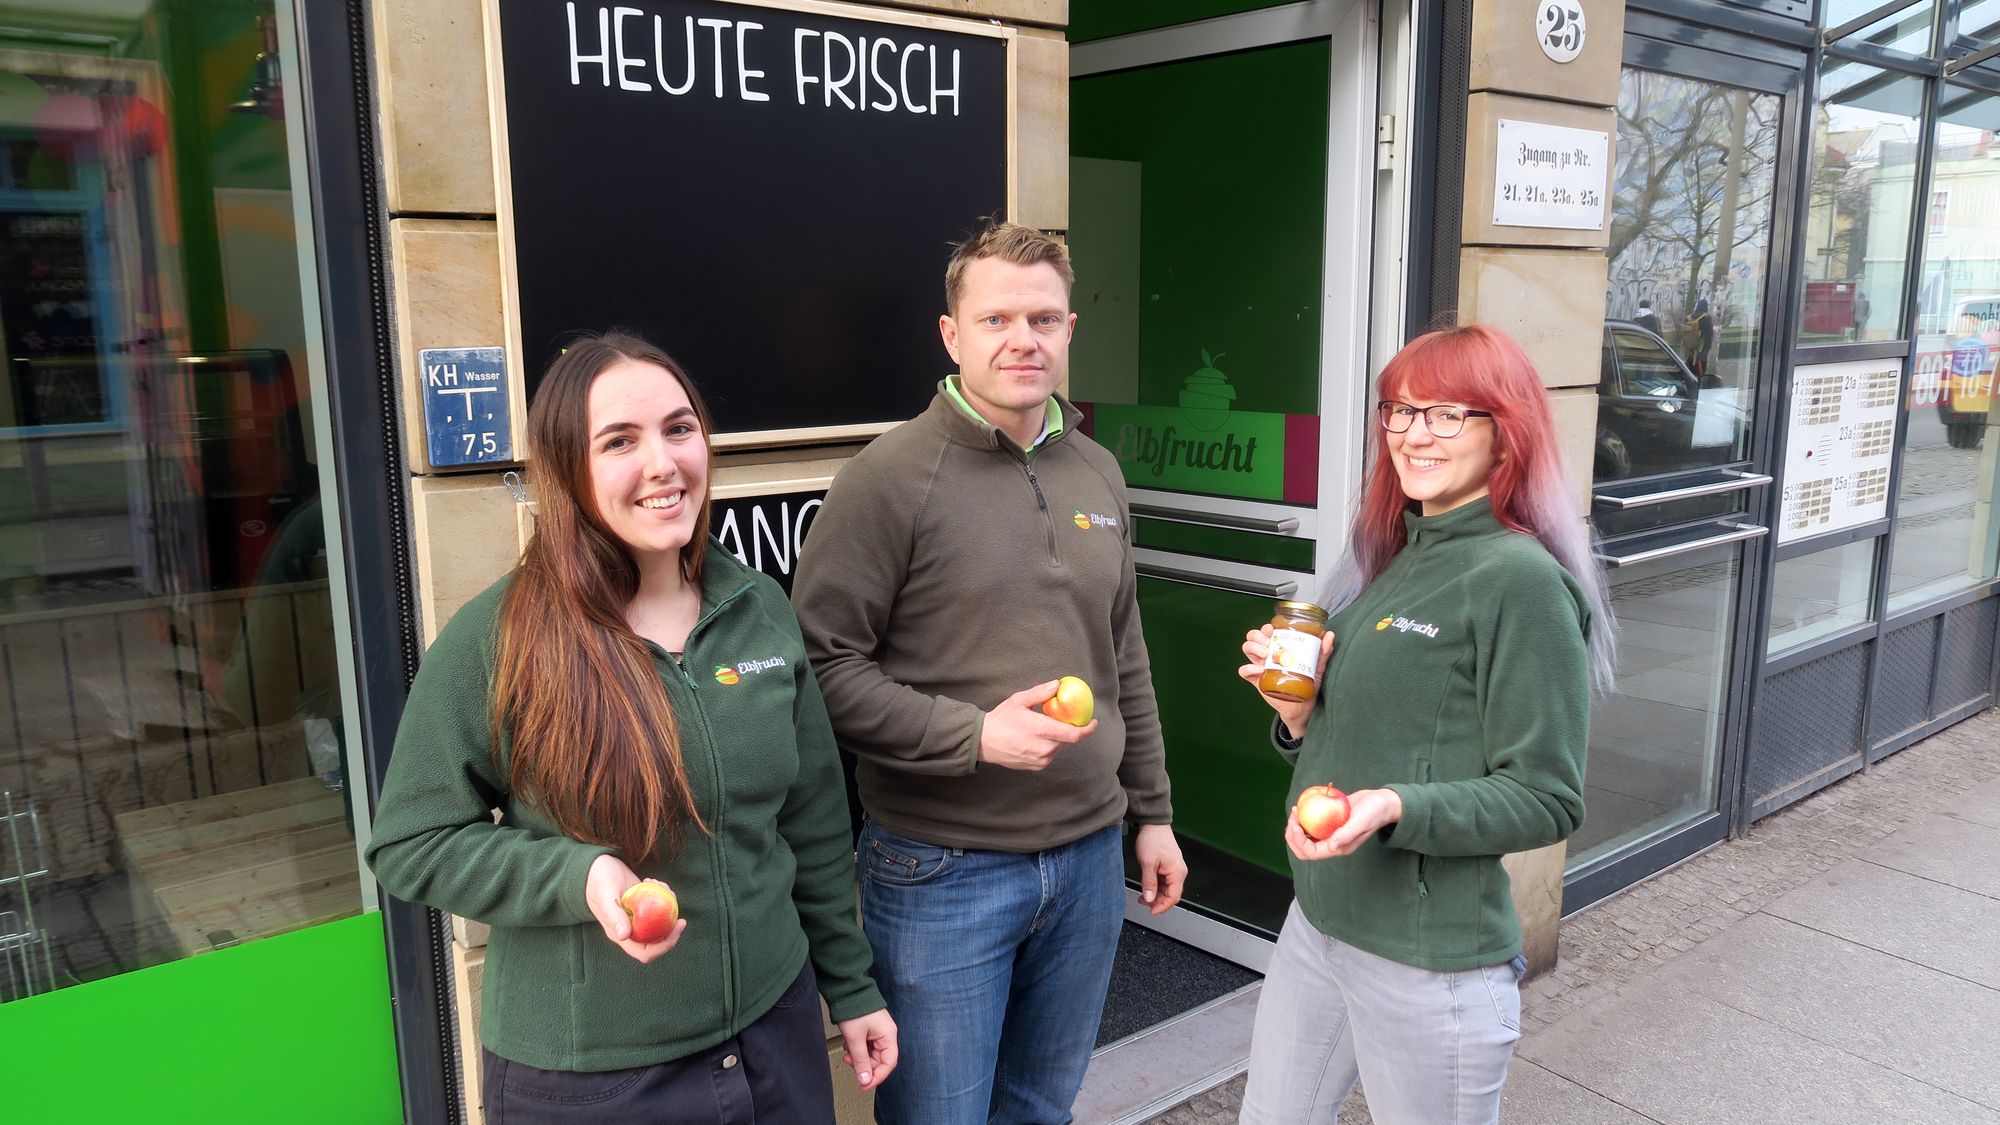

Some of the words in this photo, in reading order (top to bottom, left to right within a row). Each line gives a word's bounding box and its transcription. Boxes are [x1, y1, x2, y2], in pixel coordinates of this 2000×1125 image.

[1544, 4, 1581, 51] 25
[566, 1, 770, 101] HEUTE
[794, 27, 960, 116] FRISCH
[1517, 141, 1558, 169] Zugang
[1560, 150, 1571, 171] zu
[1573, 148, 1591, 168] Nr.
[1580, 190, 1599, 207] 25a
[428, 364, 459, 387] KH
[464, 371, 501, 382] Wasser
[1839, 426, 1853, 440] 23a
[462, 432, 497, 459] 7,5
[1115, 422, 1257, 477] Elbfrucht
[1834, 477, 1848, 491] 25a
[1391, 616, 1439, 638] Elbfrucht
[737, 656, 786, 675] Elbfrucht
